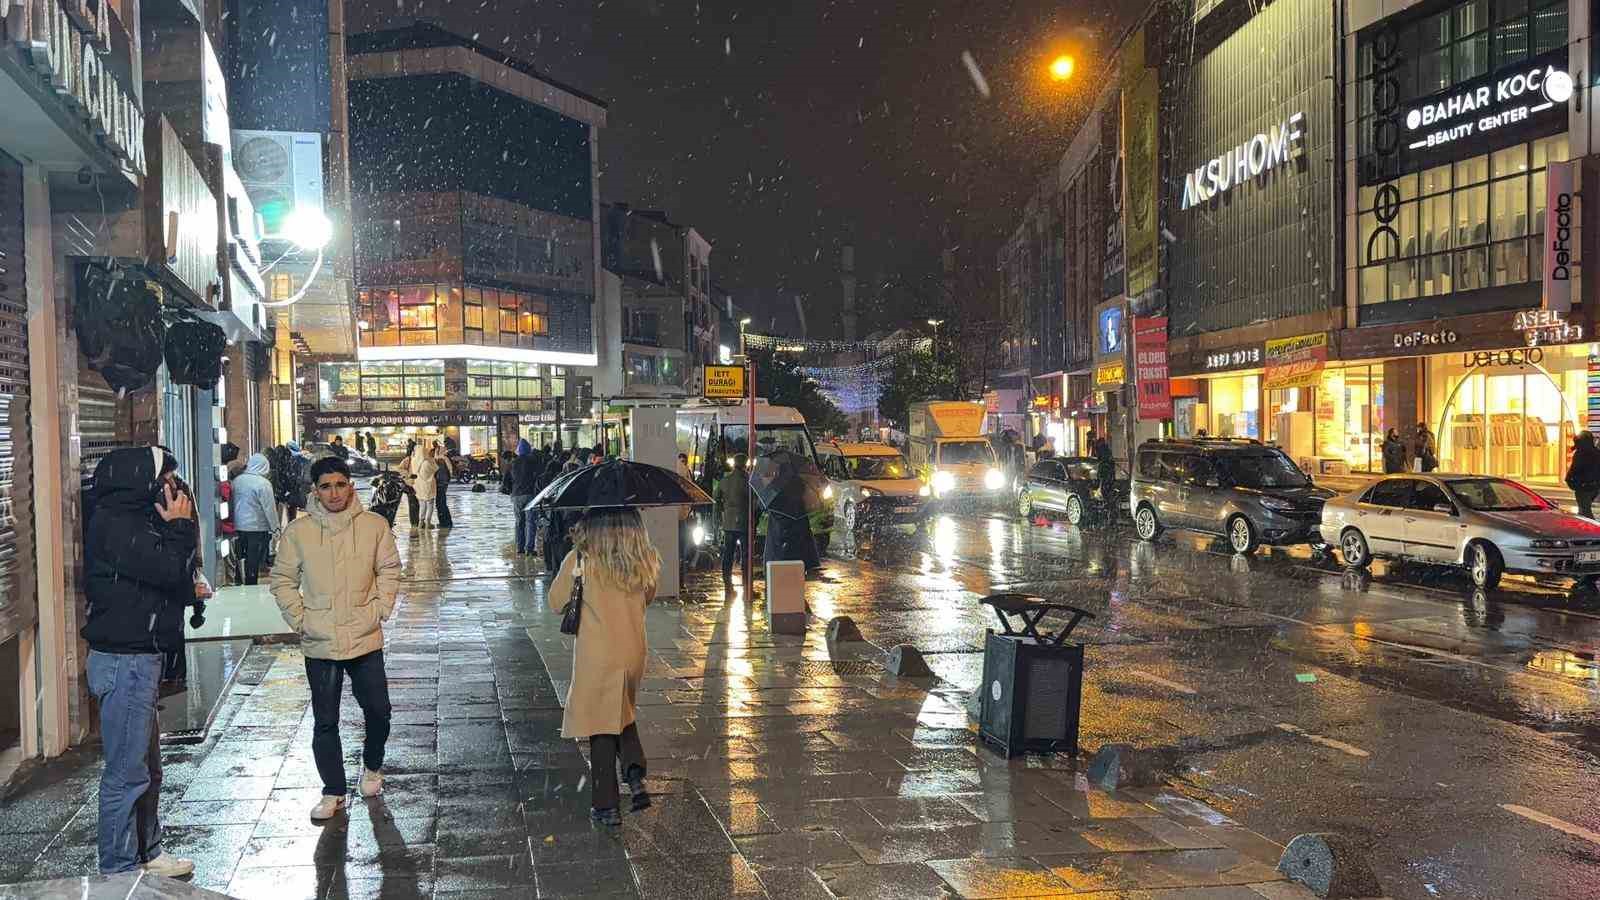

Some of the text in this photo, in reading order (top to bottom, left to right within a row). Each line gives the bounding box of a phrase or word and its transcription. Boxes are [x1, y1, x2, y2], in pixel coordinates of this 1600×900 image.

[1422, 66, 1553, 126] BAHAR KOC
[1427, 106, 1528, 147] BEAUTY CENTER
[1182, 152, 1234, 210] AKSU
[1235, 112, 1305, 184] HOME
[1553, 193, 1571, 281] DeFacto
[1393, 330, 1457, 348] DeFacto
